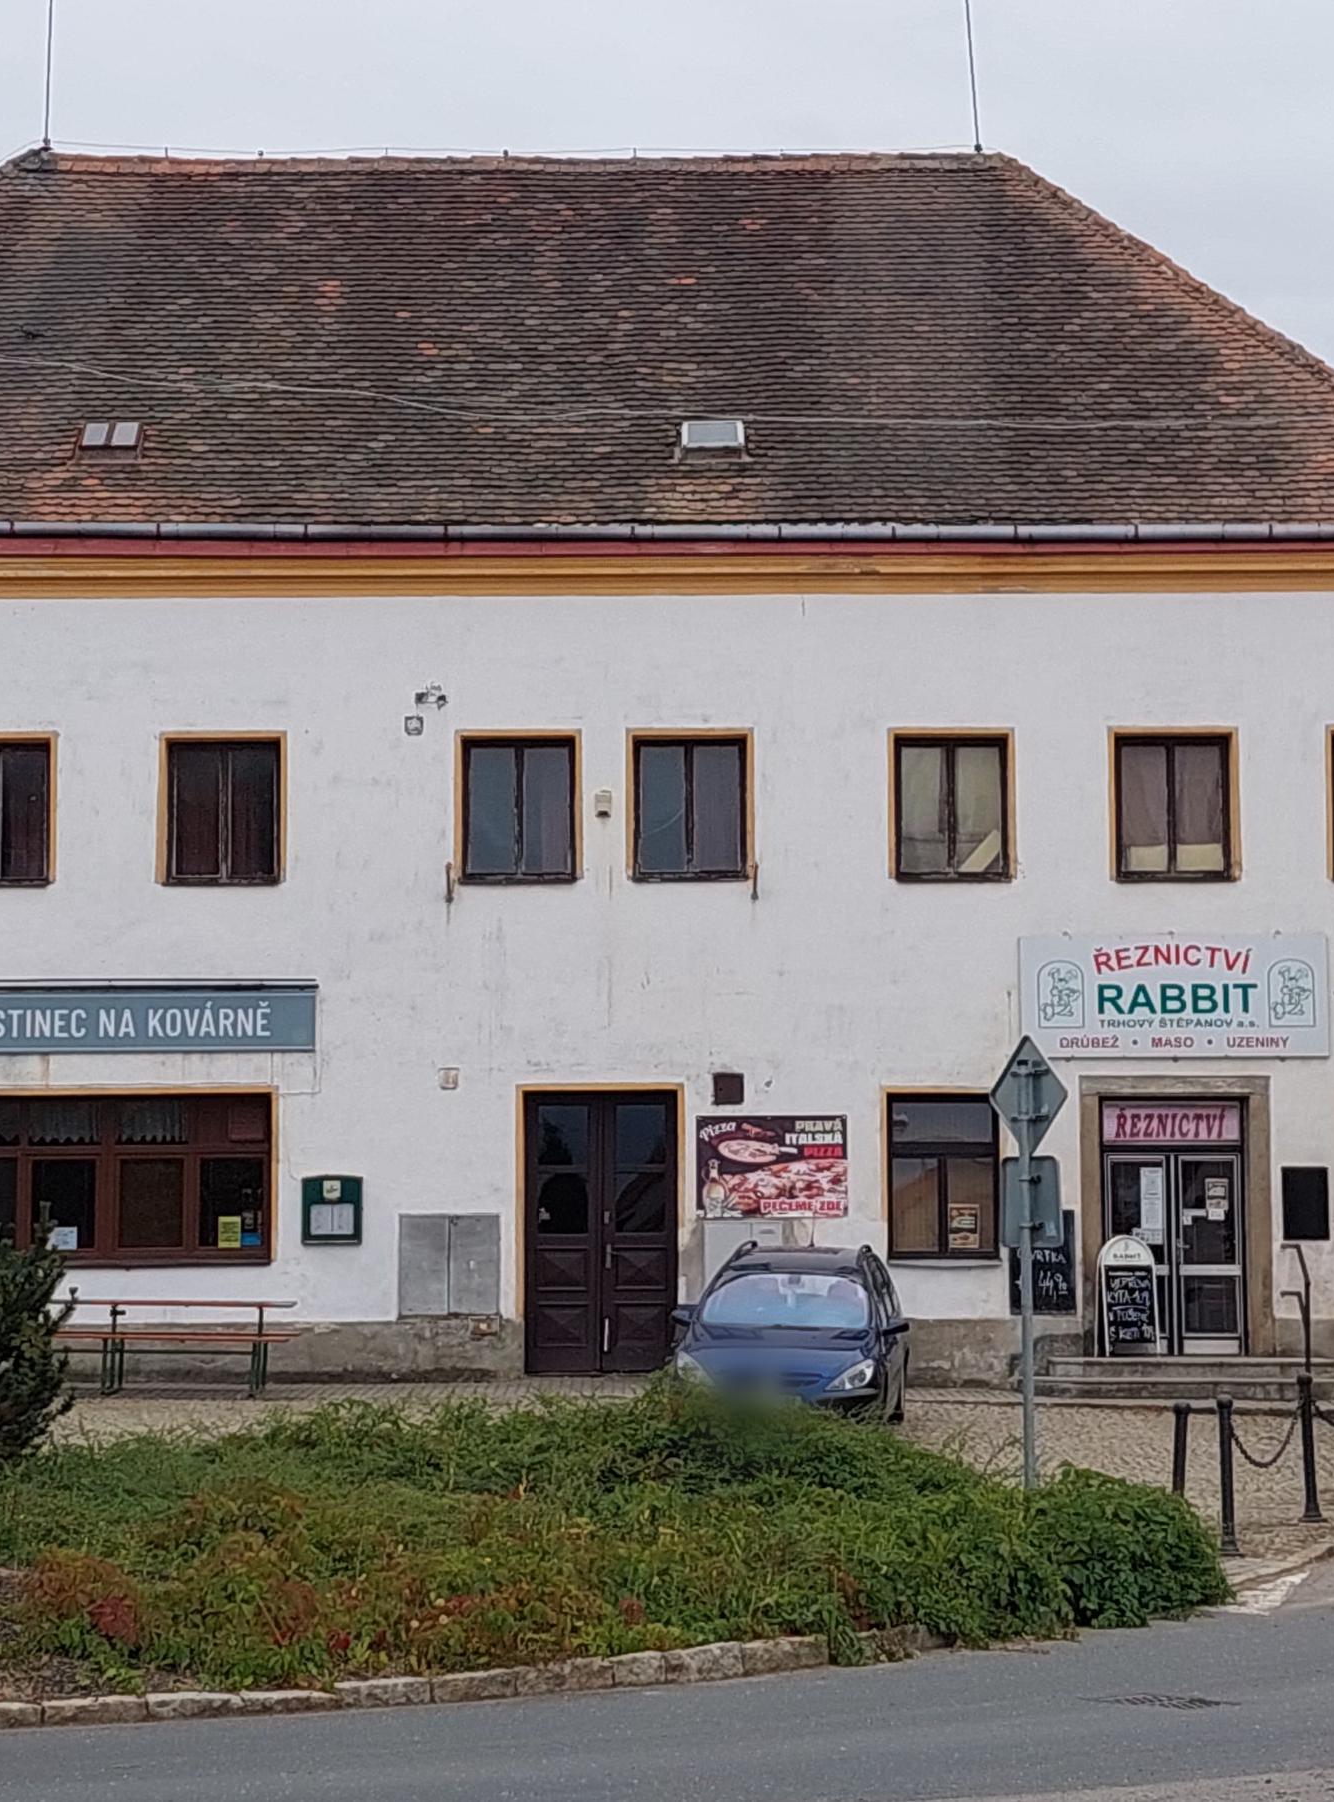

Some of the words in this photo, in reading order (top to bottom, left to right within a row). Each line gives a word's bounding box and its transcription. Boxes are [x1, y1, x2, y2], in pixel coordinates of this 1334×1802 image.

[1093, 943, 1253, 975] ŘEZNICTVÍ
[1097, 983, 1258, 1015] RABBIT
[98, 1008, 136, 1038] NA
[147, 1001, 272, 1038] KOVÁRNĚ
[1098, 1017, 1154, 1029] TRHOVÝ
[1158, 1016, 1234, 1028] ŠTĚPÁNOV
[1236, 1020, 1259, 1028] a.s.
[1150, 1036, 1194, 1049] MASO
[1226, 1036, 1290, 1049] UZENINY
[795, 1118, 843, 1132] PRAVÁ
[1114, 1107, 1227, 1139] ŘEZNICTVÍ
[699, 1121, 737, 1142] Pizza
[785, 1131, 843, 1146] ITALSKÁ
[803, 1146, 843, 1157] PIZZA
[762, 1198, 814, 1213] PEČEME
[818, 1200, 844, 1213] ZDE
